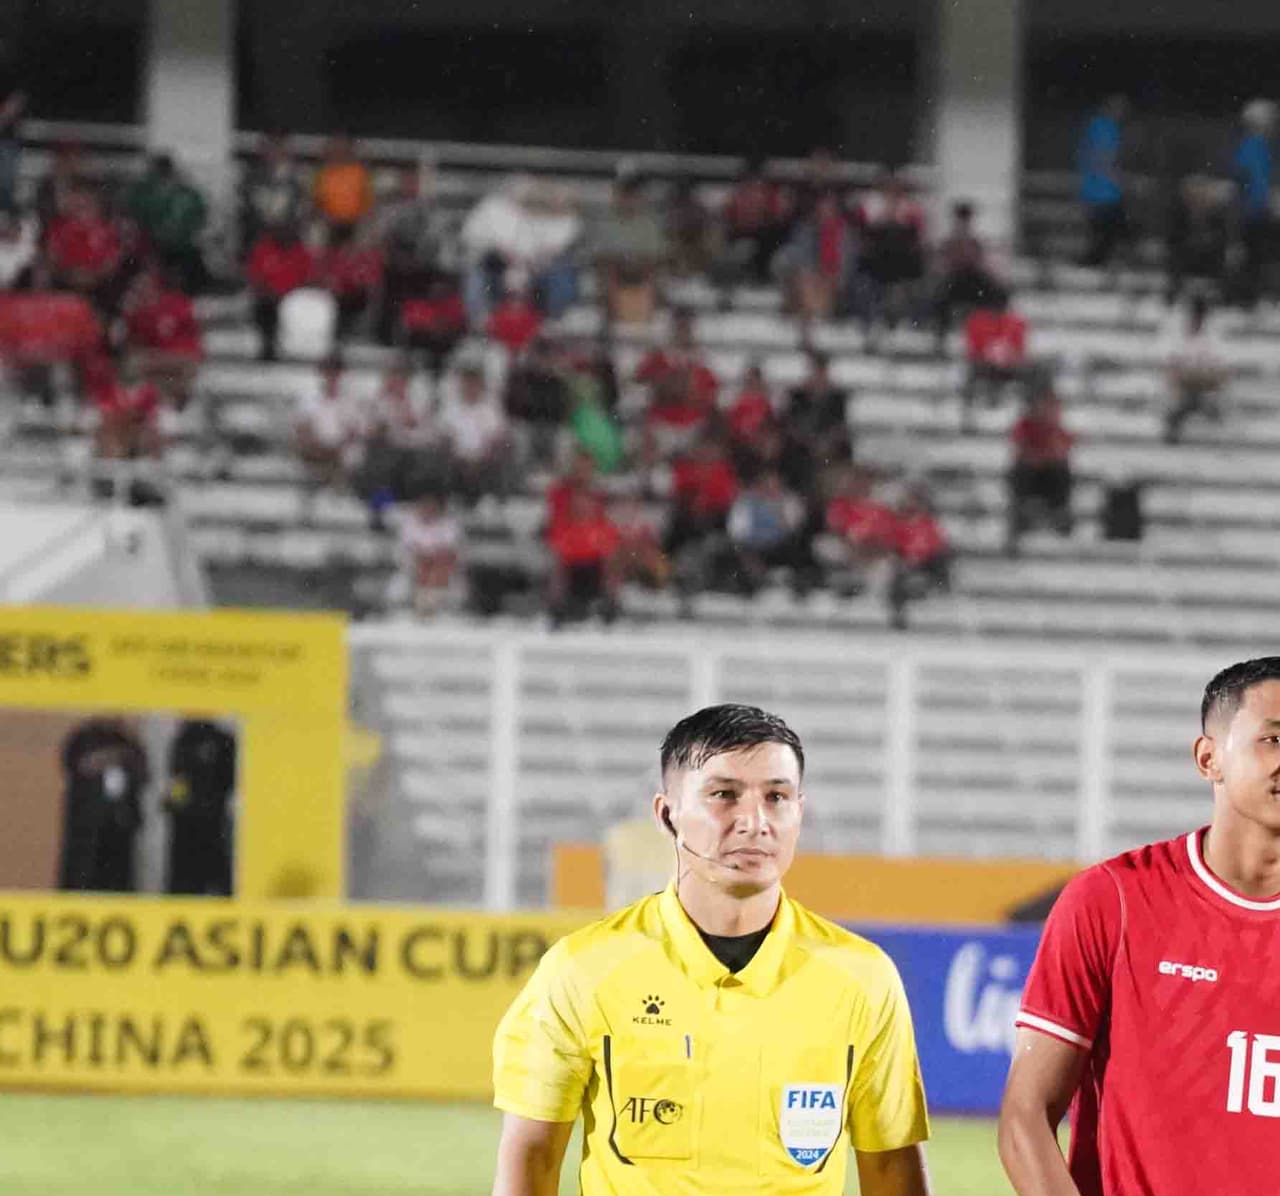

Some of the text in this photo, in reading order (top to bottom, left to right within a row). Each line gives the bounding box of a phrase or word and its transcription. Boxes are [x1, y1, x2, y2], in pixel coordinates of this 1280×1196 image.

[153, 917, 380, 976] ASIAN
[401, 924, 549, 984] CUP
[1158, 960, 1218, 982] erspo
[632, 1016, 673, 1026] KELME
[239, 1017, 396, 1078] 2025
[788, 1090, 836, 1109] FIFA
[796, 1149, 820, 1160] 2024
